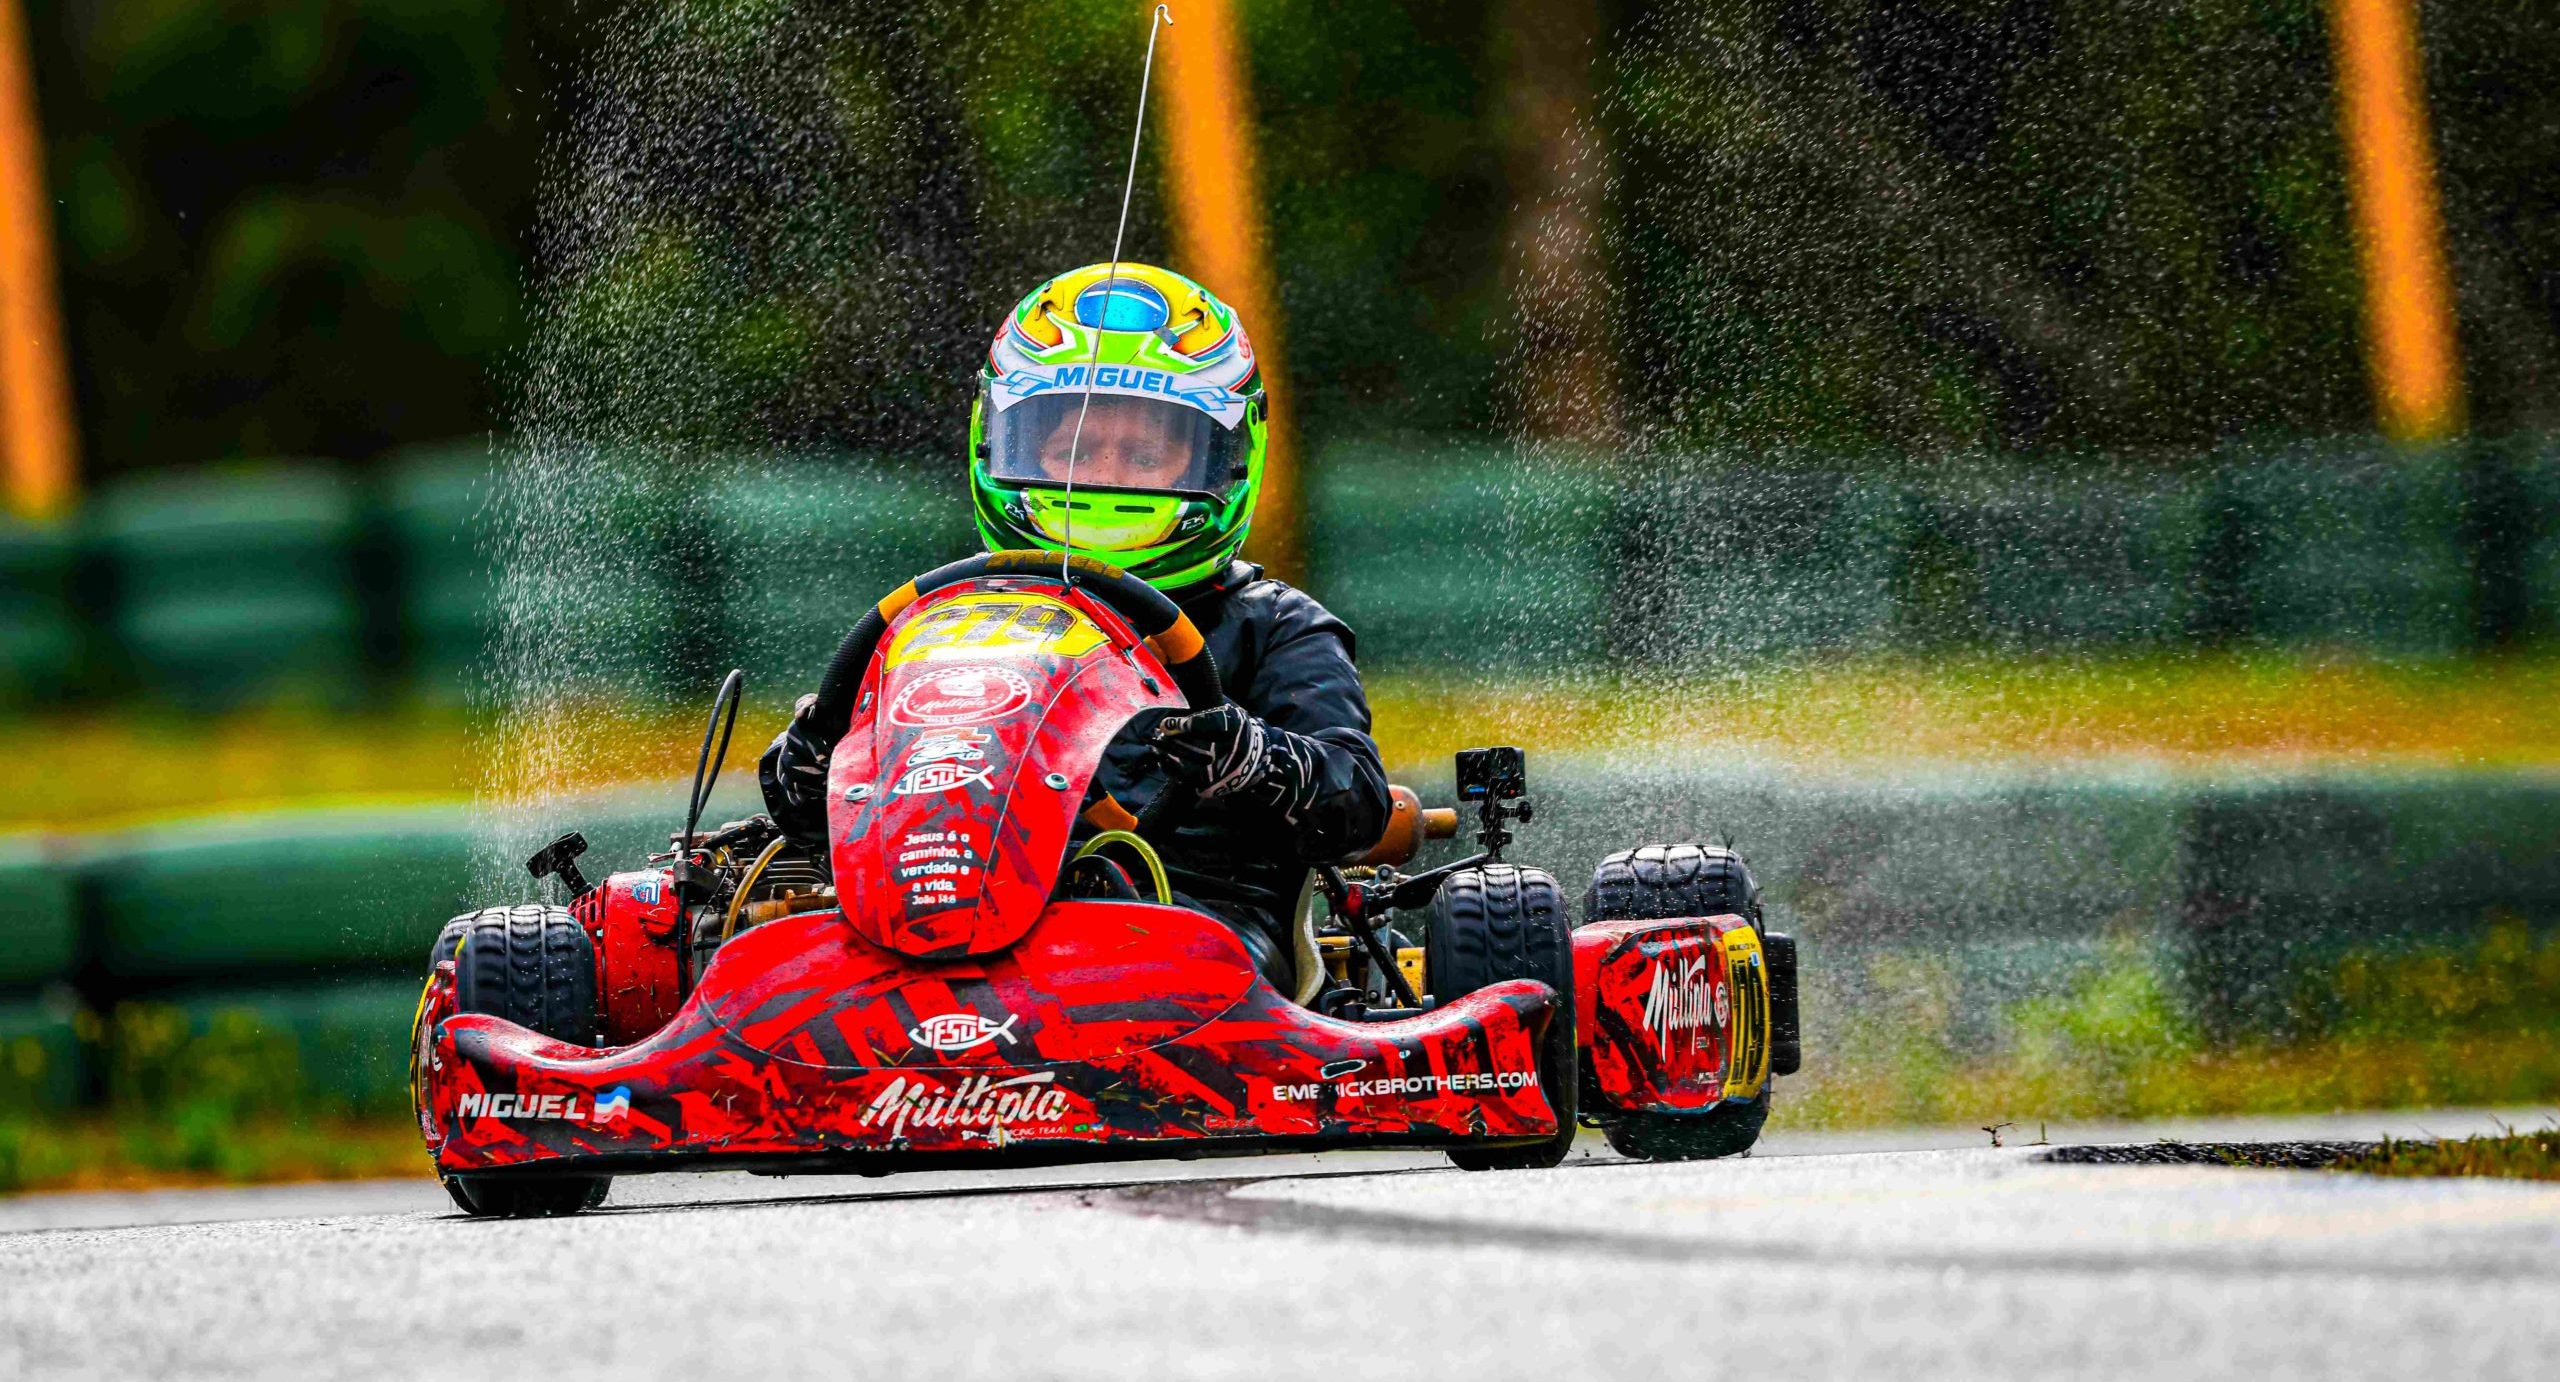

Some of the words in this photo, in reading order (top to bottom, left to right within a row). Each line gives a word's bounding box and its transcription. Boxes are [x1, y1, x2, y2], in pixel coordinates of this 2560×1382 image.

[1054, 367, 1180, 397] MIGUEL
[901, 604, 1076, 653] 279
[892, 763, 995, 795] JESUS
[903, 832, 944, 846] Jesus
[947, 829, 957, 842] é
[961, 833, 970, 843] o
[963, 849, 974, 859] a
[901, 861, 958, 877] verdade
[960, 864, 970, 876] e
[912, 882, 921, 892] a
[924, 879, 957, 891] vida.
[908, 1013, 1019, 1051] JESUS
[1272, 1071, 1539, 1101] EMEICKBROTHERS.COM
[457, 1093, 586, 1120] MIGUEL
